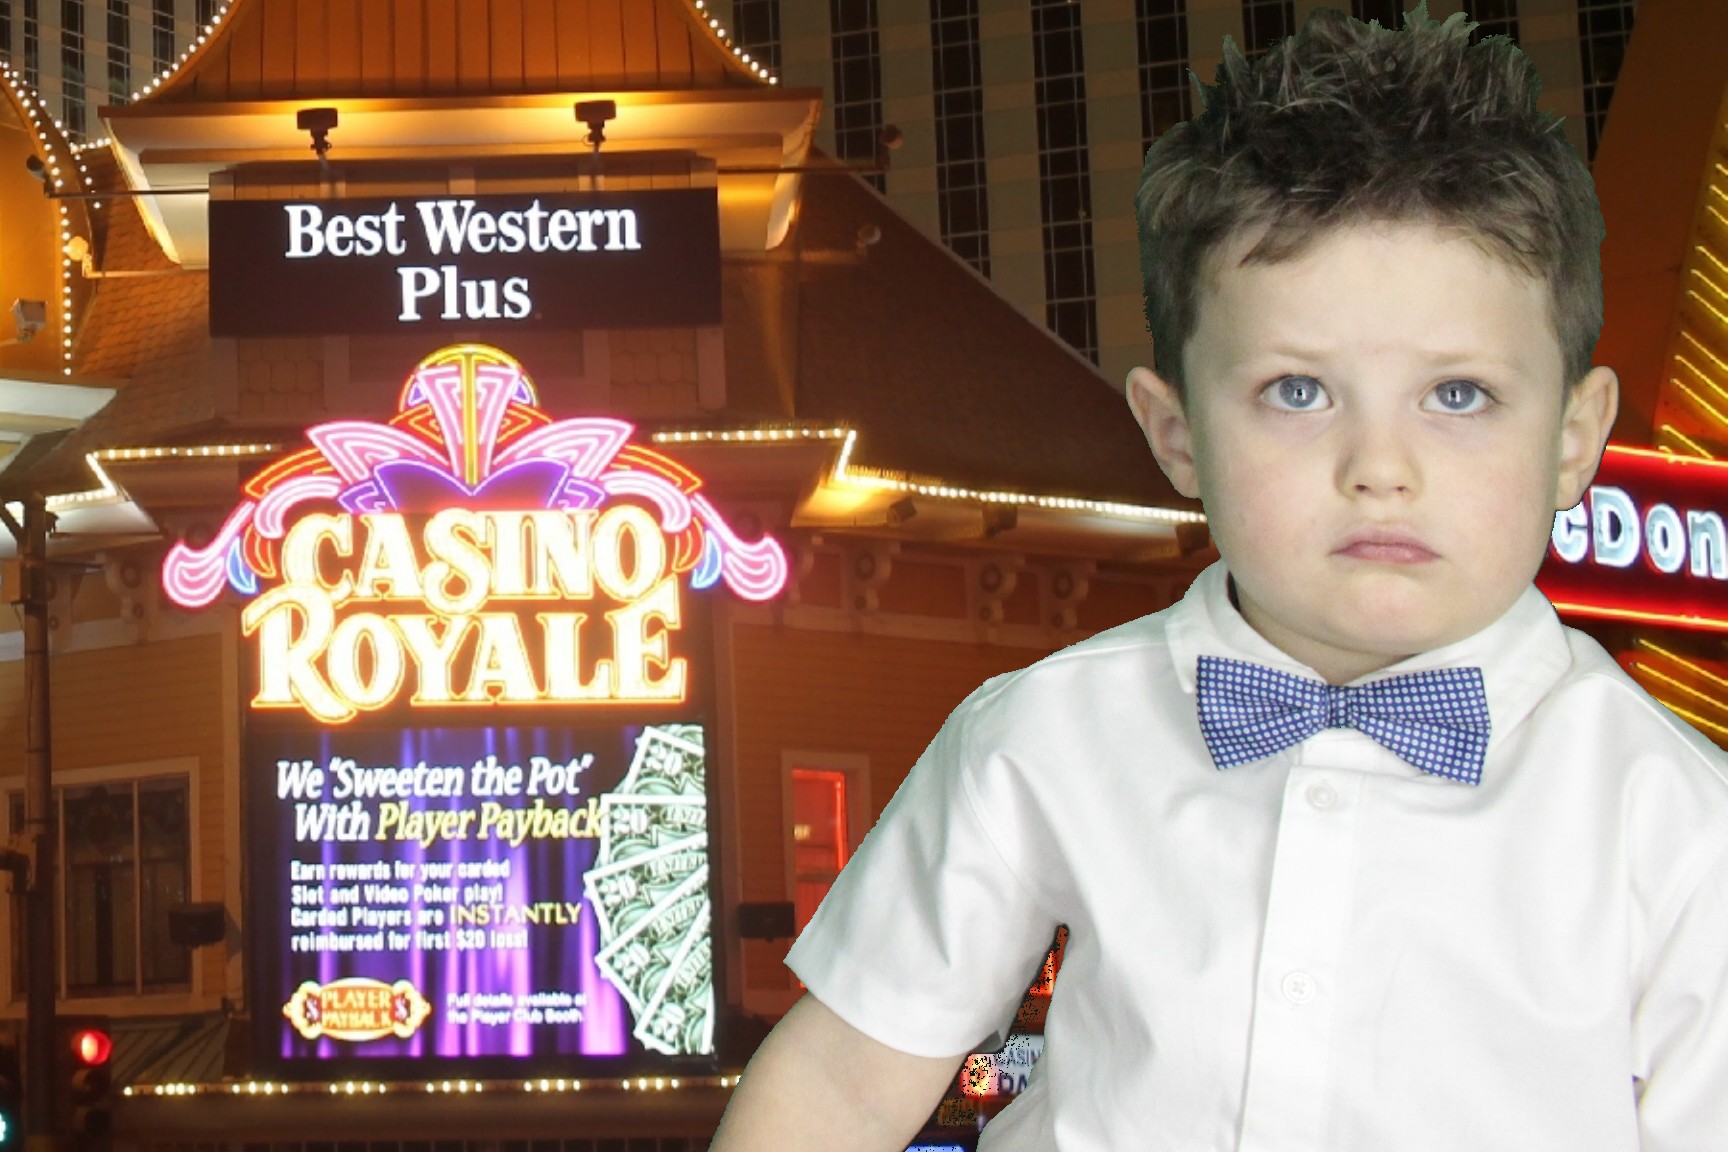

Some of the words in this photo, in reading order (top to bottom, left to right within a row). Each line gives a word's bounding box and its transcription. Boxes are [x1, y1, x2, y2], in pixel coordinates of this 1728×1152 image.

[284, 202, 406, 259] Best
[415, 198, 642, 253] Western
[397, 264, 532, 322] Plus
[280, 503, 668, 616] CASINO
[241, 573, 688, 726] ROYALE
[277, 760, 325, 799] We
[471, 754, 523, 797] the
[295, 800, 372, 843] With
[375, 800, 477, 849] Player
[477, 798, 603, 848] Payback
[291, 860, 326, 880] Earn
[329, 860, 391, 880] rewards
[395, 860, 415, 880] for
[420, 861, 454, 882] your
[291, 884, 324, 905] Slot
[330, 884, 359, 905] and
[363, 884, 409, 904] Video
[413, 883, 459, 903] Poker
[291, 906, 348, 927] Carded
[352, 906, 412, 931] Players
[417, 909, 444, 927] are
[450, 902, 582, 926] INSTANTLY
[387, 930, 412, 951] for
[414, 929, 451, 951] first
[456, 928, 487, 951] $20
[321, 989, 391, 1009] PLAYER
